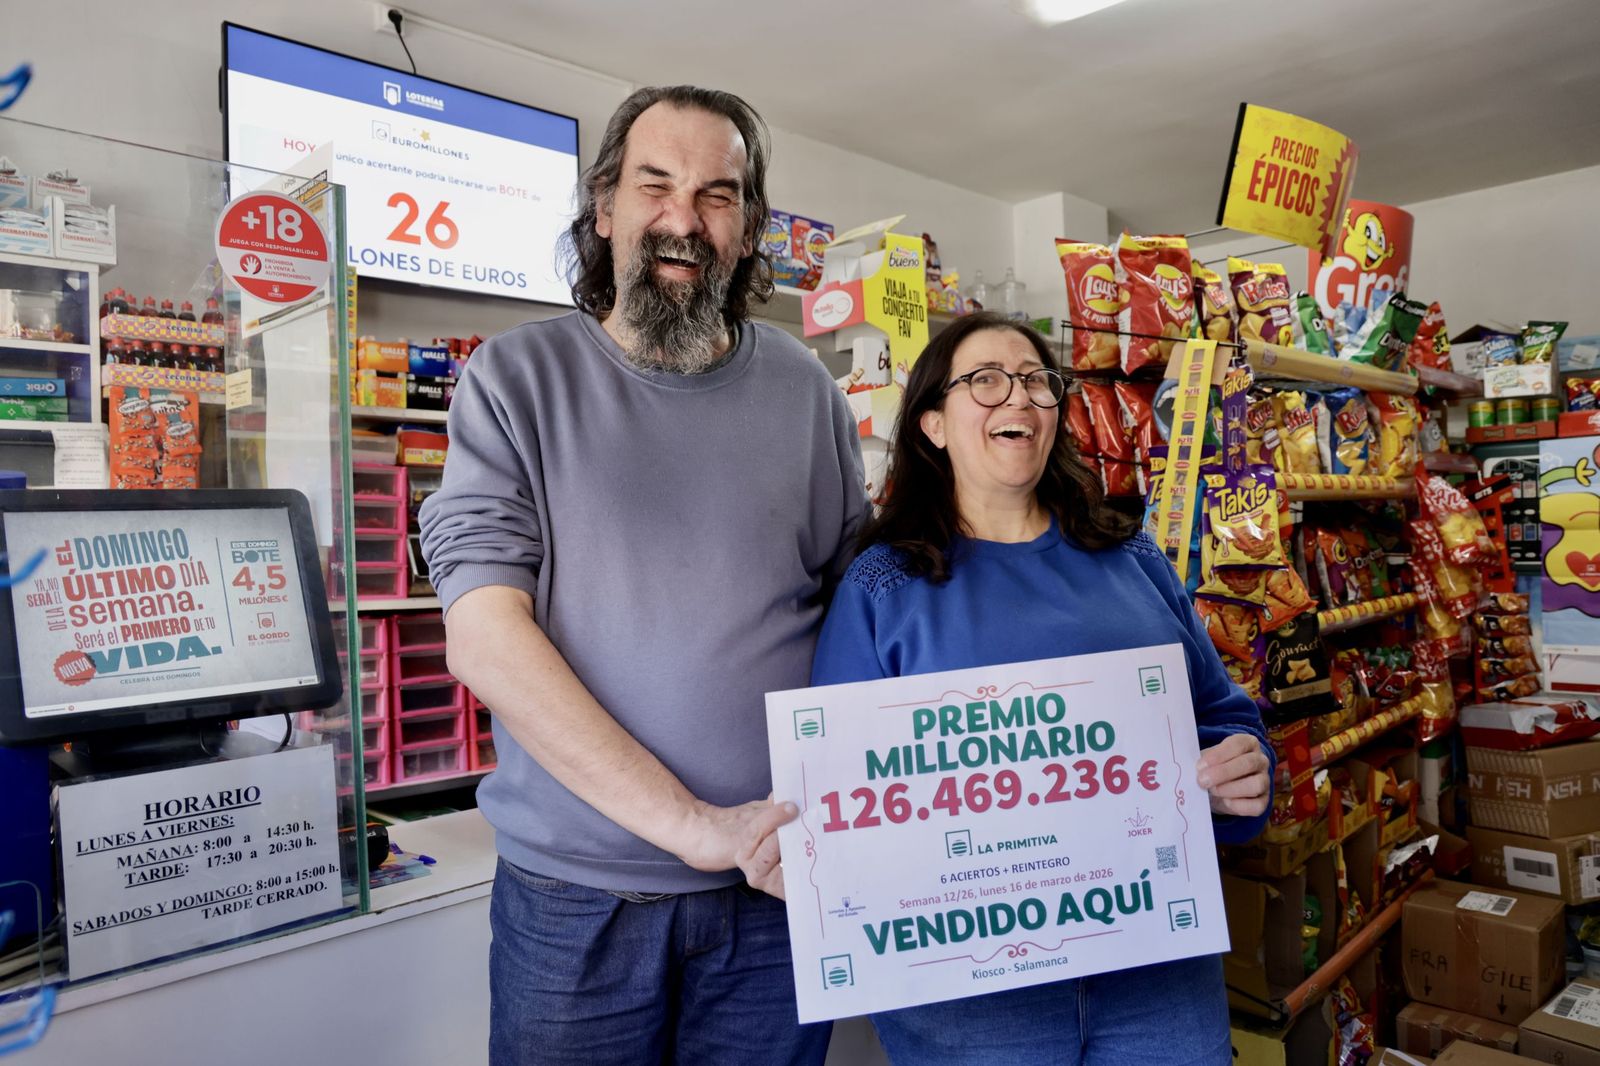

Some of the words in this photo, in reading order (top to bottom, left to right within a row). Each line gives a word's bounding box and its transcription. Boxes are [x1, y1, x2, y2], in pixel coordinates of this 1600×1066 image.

[283, 137, 316, 153] HOY
[392, 136, 470, 160] EUROMILLONES
[1271, 135, 1319, 170] PRECIOS
[366, 158, 412, 175] acertante
[448, 175, 483, 190] llevarse
[486, 184, 497, 192] un
[499, 184, 528, 199] BOTE
[1247, 153, 1320, 217] ÉPICOS
[241, 205, 303, 243] +18
[386, 191, 460, 250] 26
[229, 238, 249, 246] JUEGA
[250, 240, 264, 248] CON
[265, 242, 319, 256] RESPONSABILIDAD
[889, 252, 920, 267] bueno
[265, 258, 293, 266] PROHIBIDA
[429, 258, 455, 278] DE
[462, 265, 527, 288] EUROS
[885, 277, 907, 301] VIAJA
[882, 296, 925, 323] CONCIERTO
[898, 318, 912, 338] FAV
[381, 347, 406, 356] HALLS
[422, 351, 446, 360] HALLS
[26, 382, 57, 393] Orbit
[418, 385, 442, 394] HALLS
[1222, 374, 1250, 400] Takis
[1214, 482, 1269, 522] Takis
[55, 540, 75, 566] EL
[73, 528, 190, 571] DOMINGO
[34, 579, 47, 592] YA
[47, 578, 60, 590] NO
[62, 568, 176, 601] ÚLTIMO
[178, 556, 210, 588] DÍA
[232, 565, 287, 595] 4,5
[26, 589, 53, 607] SERÁ
[53, 591, 63, 604] EL
[68, 590, 204, 628] semana.
[239, 596, 283, 605] MILLONES
[45, 606, 66, 619] LA
[48, 618, 67, 632] DE
[74, 629, 106, 650] Será
[107, 627, 118, 645] el
[120, 616, 191, 643] PRIMERO
[193, 618, 206, 632] DE
[206, 616, 216, 630] TU
[259, 631, 290, 640] GORDO
[58, 657, 92, 679] NUEVA
[88, 636, 223, 674] VIDA.
[1265, 636, 1319, 676] Gourmet
[120, 676, 150, 685] CELEBRA
[166, 671, 201, 680] DOMINGOS
[912, 692, 1067, 740] PREMIO
[865, 720, 1116, 781] MILLONARIO
[144, 785, 261, 821] HORARIO
[820, 755, 1131, 834] 126.469.236
[1136, 758, 1161, 792] €
[76, 831, 137, 854] LUNES
[140, 828, 152, 842] A
[157, 814, 235, 838] VIERNES:
[116, 843, 199, 870] MAÑANA:
[203, 835, 232, 852] 8:00
[243, 834, 251, 843] a
[266, 821, 300, 839] 14:30
[303, 820, 315, 832] h.
[978, 843, 993, 855] LA
[997, 834, 1058, 852] PRIMITIVA
[1128, 827, 1153, 838] JOKER
[124, 862, 190, 886] TARDE:
[207, 851, 242, 868] 17:30
[250, 850, 258, 860] a
[268, 839, 302, 856] 20:30
[305, 835, 317, 848] h.
[940, 874, 948, 884] 6
[949, 866, 1001, 883] ACIERTOS
[1011, 856, 1071, 873] REINTEGRO
[73, 906, 152, 934] SABADOS
[156, 902, 168, 914] Y
[172, 883, 253, 911] DOMINGO:
[255, 874, 282, 891] 8:00
[284, 874, 292, 884] a
[295, 864, 326, 882] 15:00
[328, 863, 340, 874] h.
[201, 897, 253, 920] TARDE
[256, 880, 328, 907] CERRADO.
[899, 896, 942, 909] Semana
[943, 889, 977, 903] 12/26,
[979, 885, 1007, 897] lunes
[1010, 882, 1023, 893] 16
[1025, 880, 1039, 890] de
[1040, 876, 1072, 888] marzo
[1074, 872, 1087, 883] de
[1089, 868, 1114, 881] 2026
[863, 897, 1047, 956] VENDIDO
[1056, 868, 1154, 925] AQUÍ
[972, 967, 1006, 980] Kiosco
[1013, 956, 1069, 973] Salamanca
[1481, 965, 1532, 992] GILE
